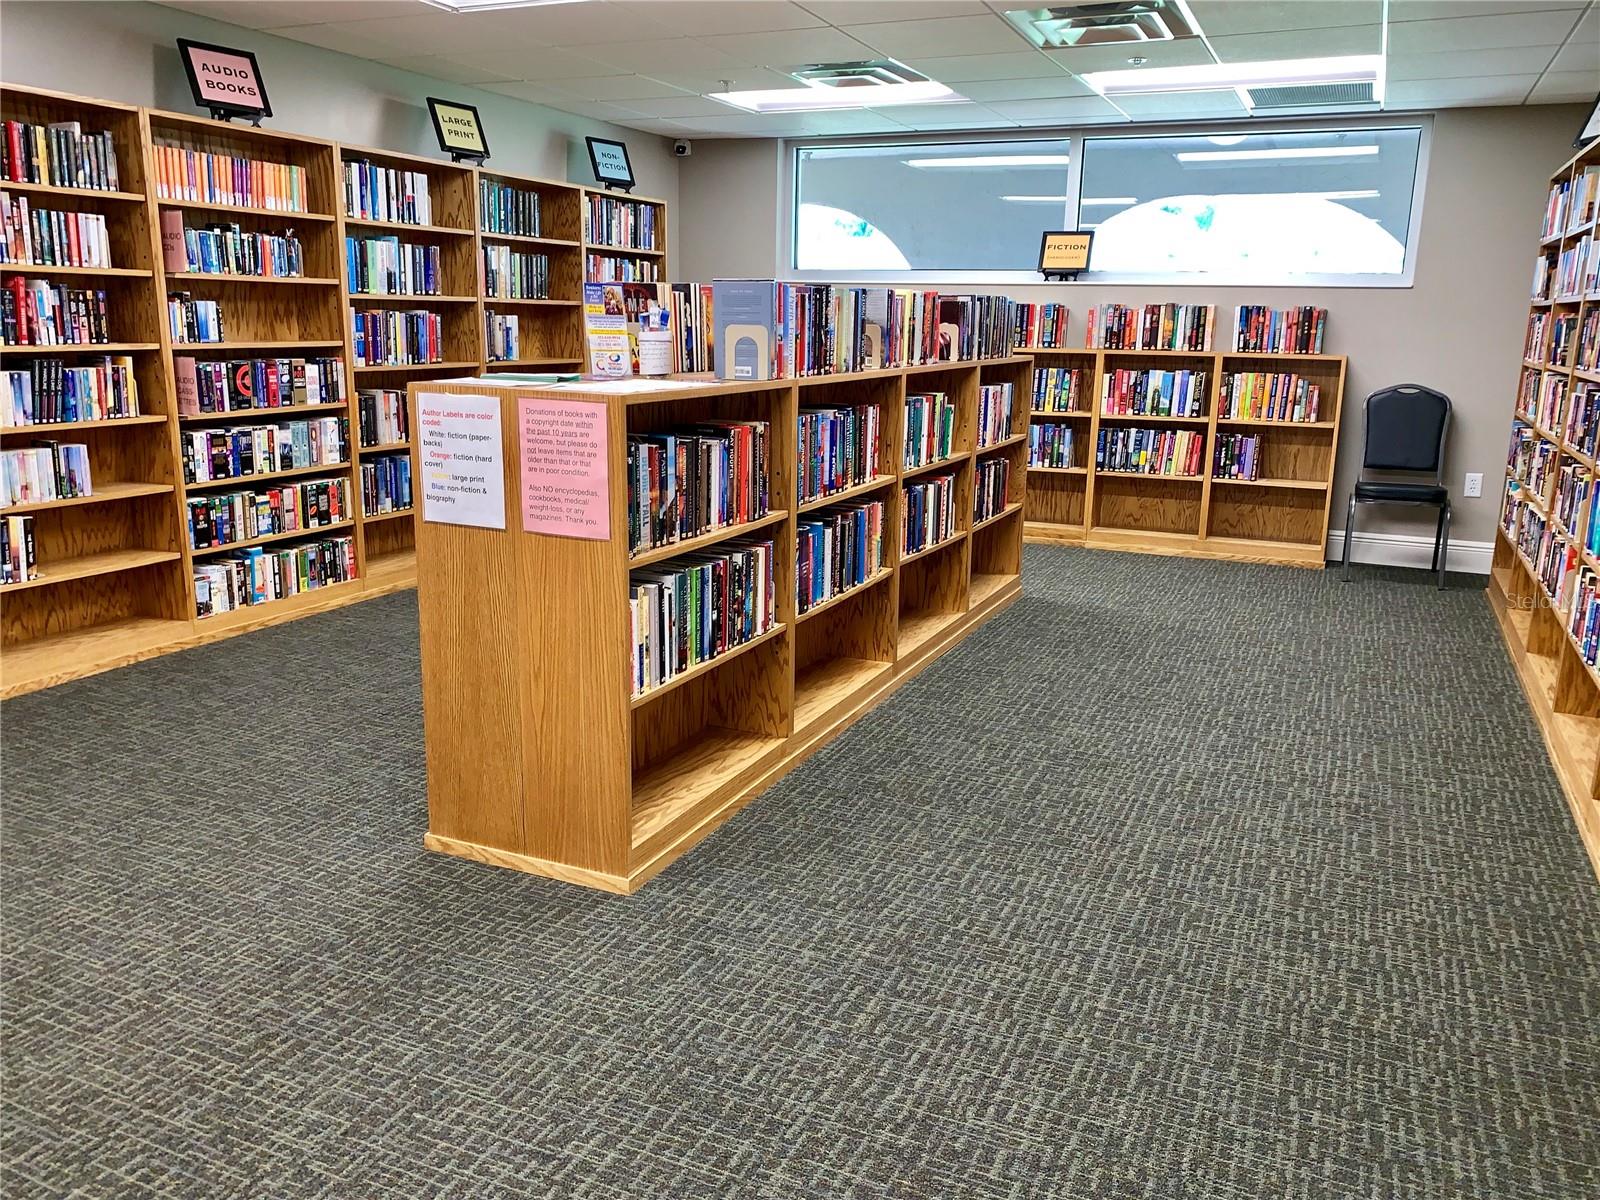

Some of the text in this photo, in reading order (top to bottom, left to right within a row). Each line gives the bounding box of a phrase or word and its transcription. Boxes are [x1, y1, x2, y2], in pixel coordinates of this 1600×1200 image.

[202, 63, 248, 79] AUDIO
[206, 80, 256, 96] BOOKS
[442, 115, 472, 128] LARGE
[448, 129, 474, 140] PRINT
[601, 152, 620, 160] NON-
[598, 162, 626, 172] FICTION
[176, 376, 194, 384] AUDIO
[526, 408, 556, 416] Donations
[532, 418, 559, 427] copyright
[469, 433, 492, 441] (paper-
[424, 440, 443, 448] backs)
[430, 451, 452, 460] Orange:
[475, 455, 492, 463] (hard
[561, 469, 590, 477] condition.
[452, 474, 467, 482] large
[470, 474, 484, 482] print
[447, 485, 481, 493] non-fiction
[555, 488, 600, 498] encyclopedias,
[427, 494, 456, 504] biography
[529, 495, 563, 504] cookbooks,
[529, 504, 564, 513] weight-loss,
[574, 508, 584, 516] any
